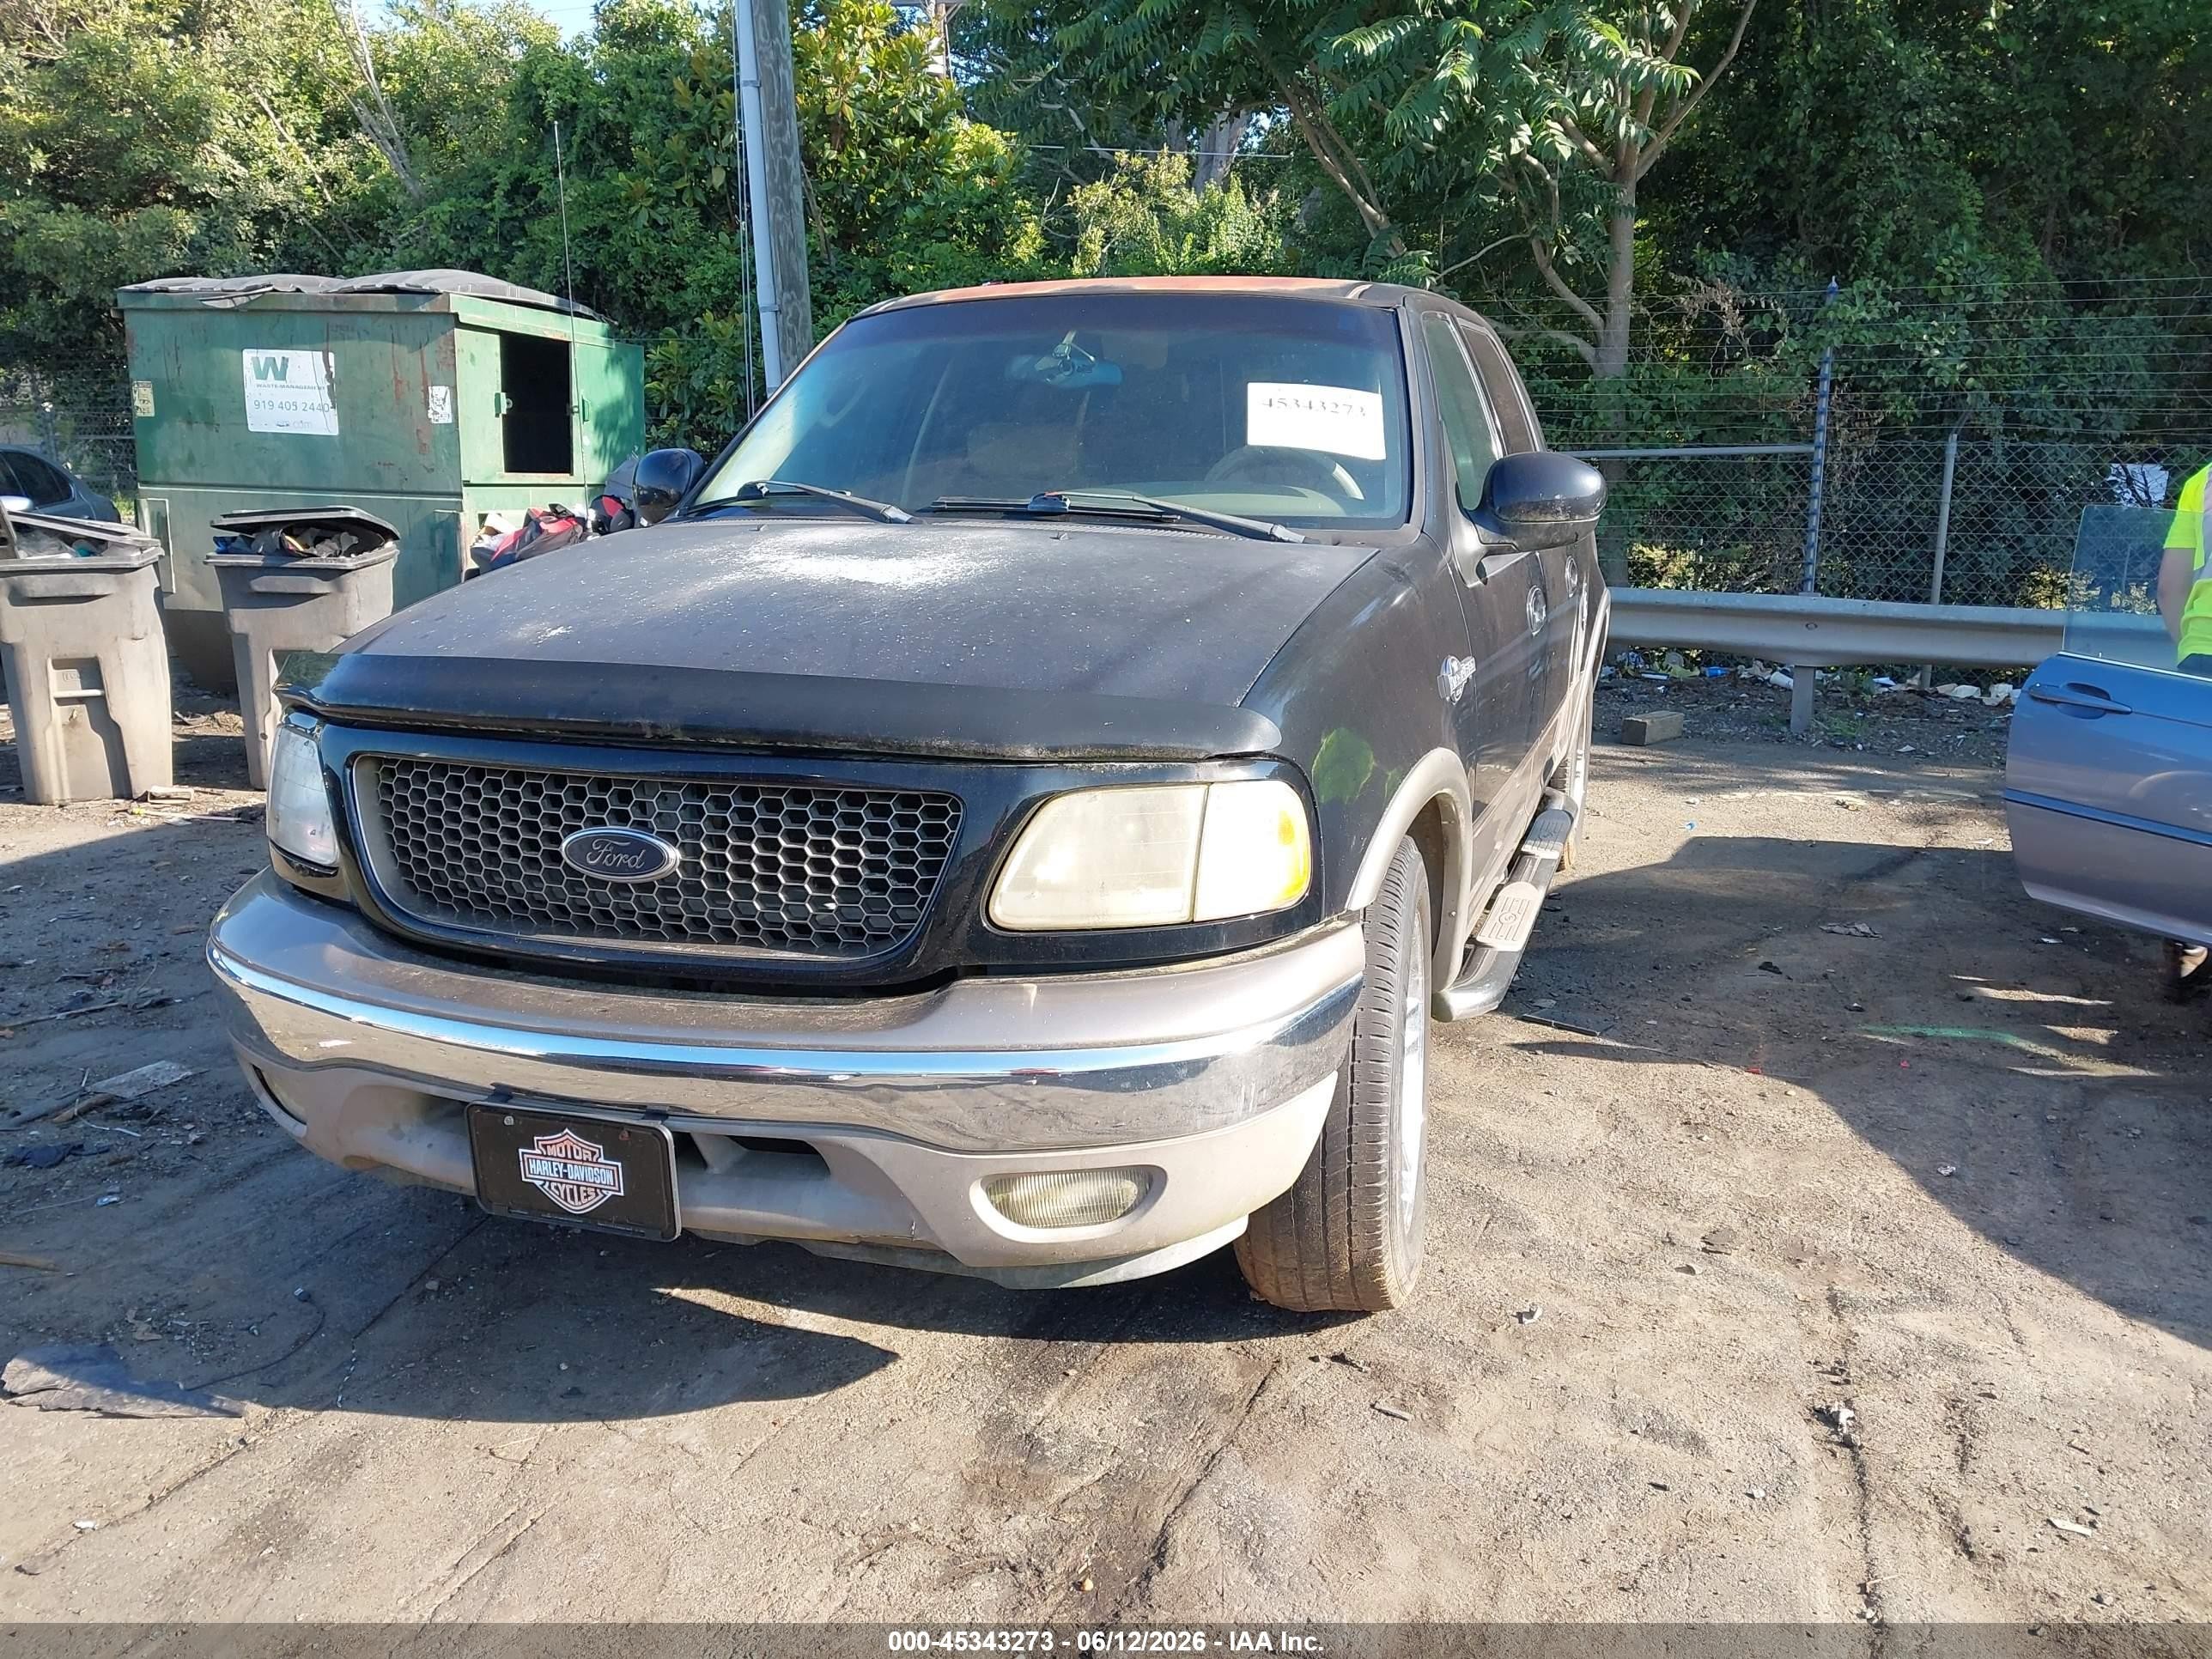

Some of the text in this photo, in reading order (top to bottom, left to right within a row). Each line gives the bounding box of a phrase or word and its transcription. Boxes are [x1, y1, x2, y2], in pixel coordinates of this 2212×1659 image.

[253, 399, 275, 410] 919
[301, 402, 330, 413] 2440
[586, 838, 647, 869] Ford
[546, 1139, 593, 1162] MOTOR
[528, 1158, 614, 1186] HARLEY-DAVIDSON
[550, 1182, 596, 1206] CYCLES
